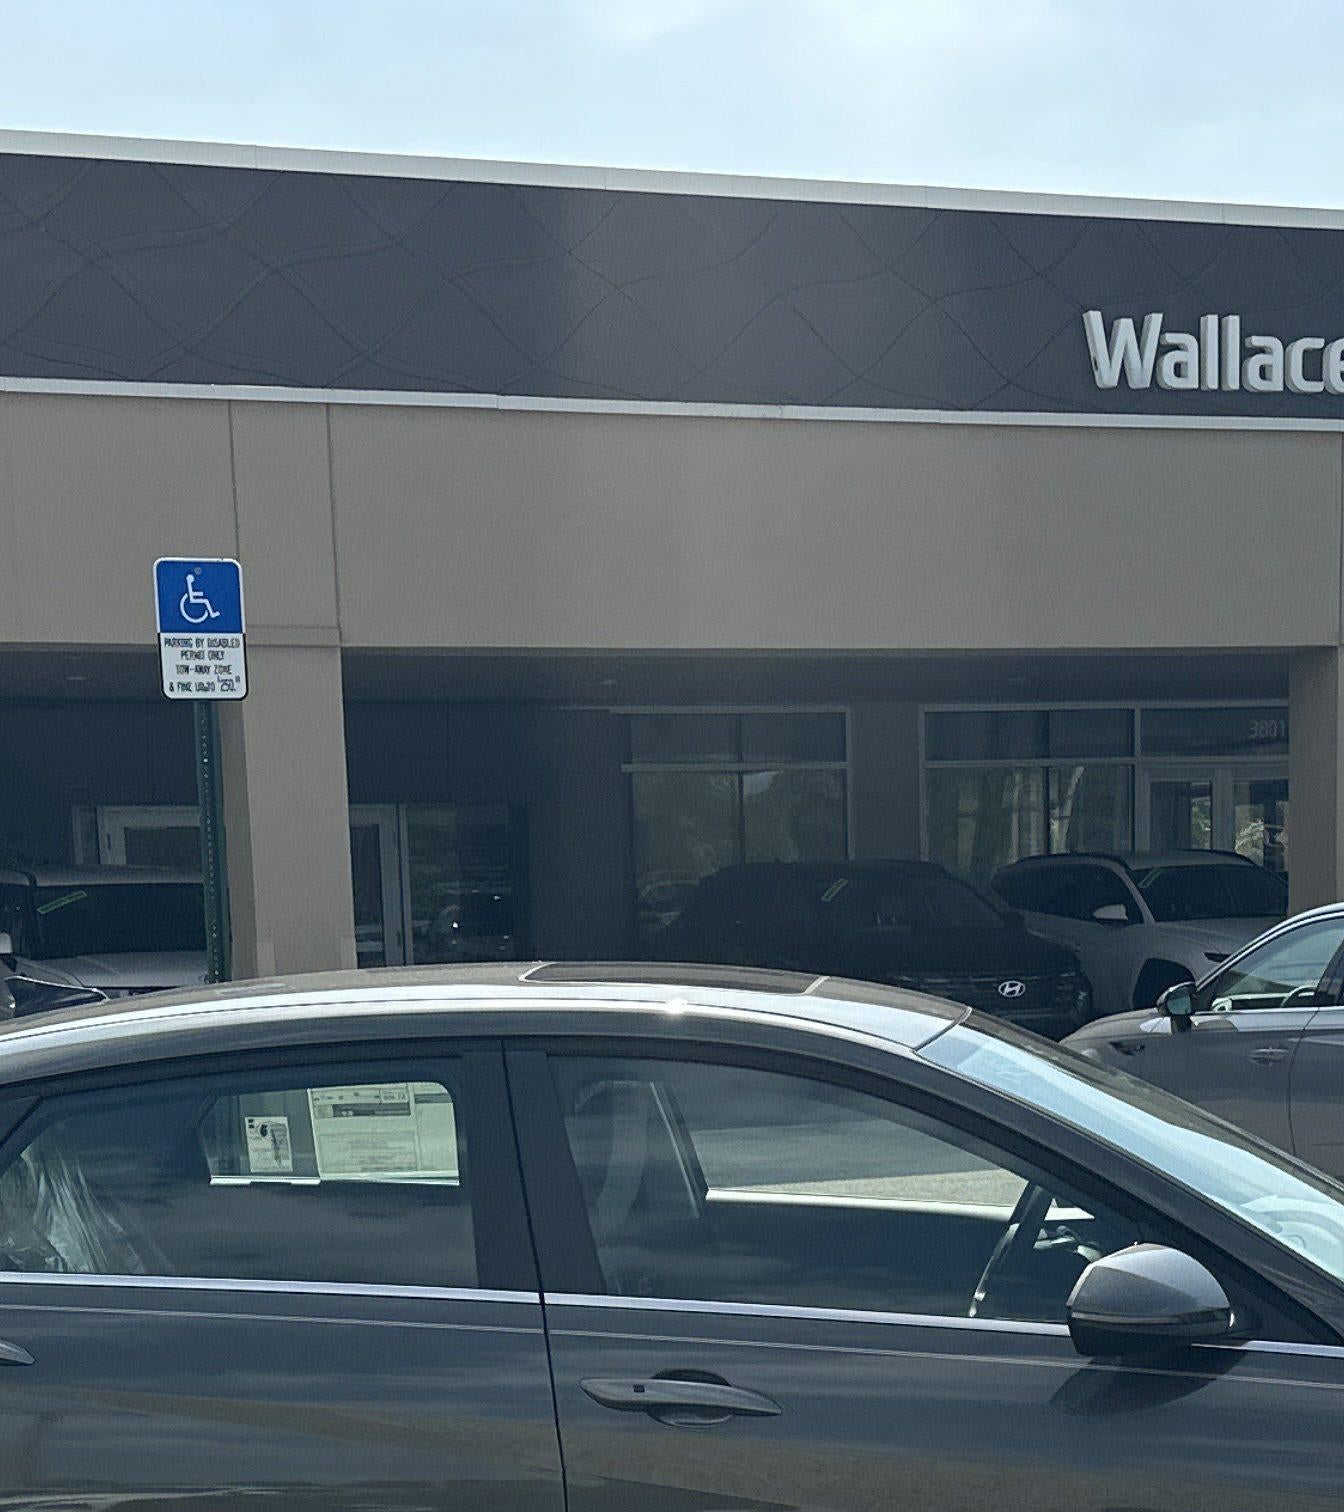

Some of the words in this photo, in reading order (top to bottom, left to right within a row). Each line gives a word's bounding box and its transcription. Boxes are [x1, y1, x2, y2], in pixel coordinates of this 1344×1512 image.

[164, 637, 193, 648] PARKING
[196, 638, 204, 648] BY
[207, 638, 241, 648] DISABLED
[180, 650, 205, 660] PERMIT
[208, 650, 225, 660] ONLY
[214, 664, 232, 675] ZONE
